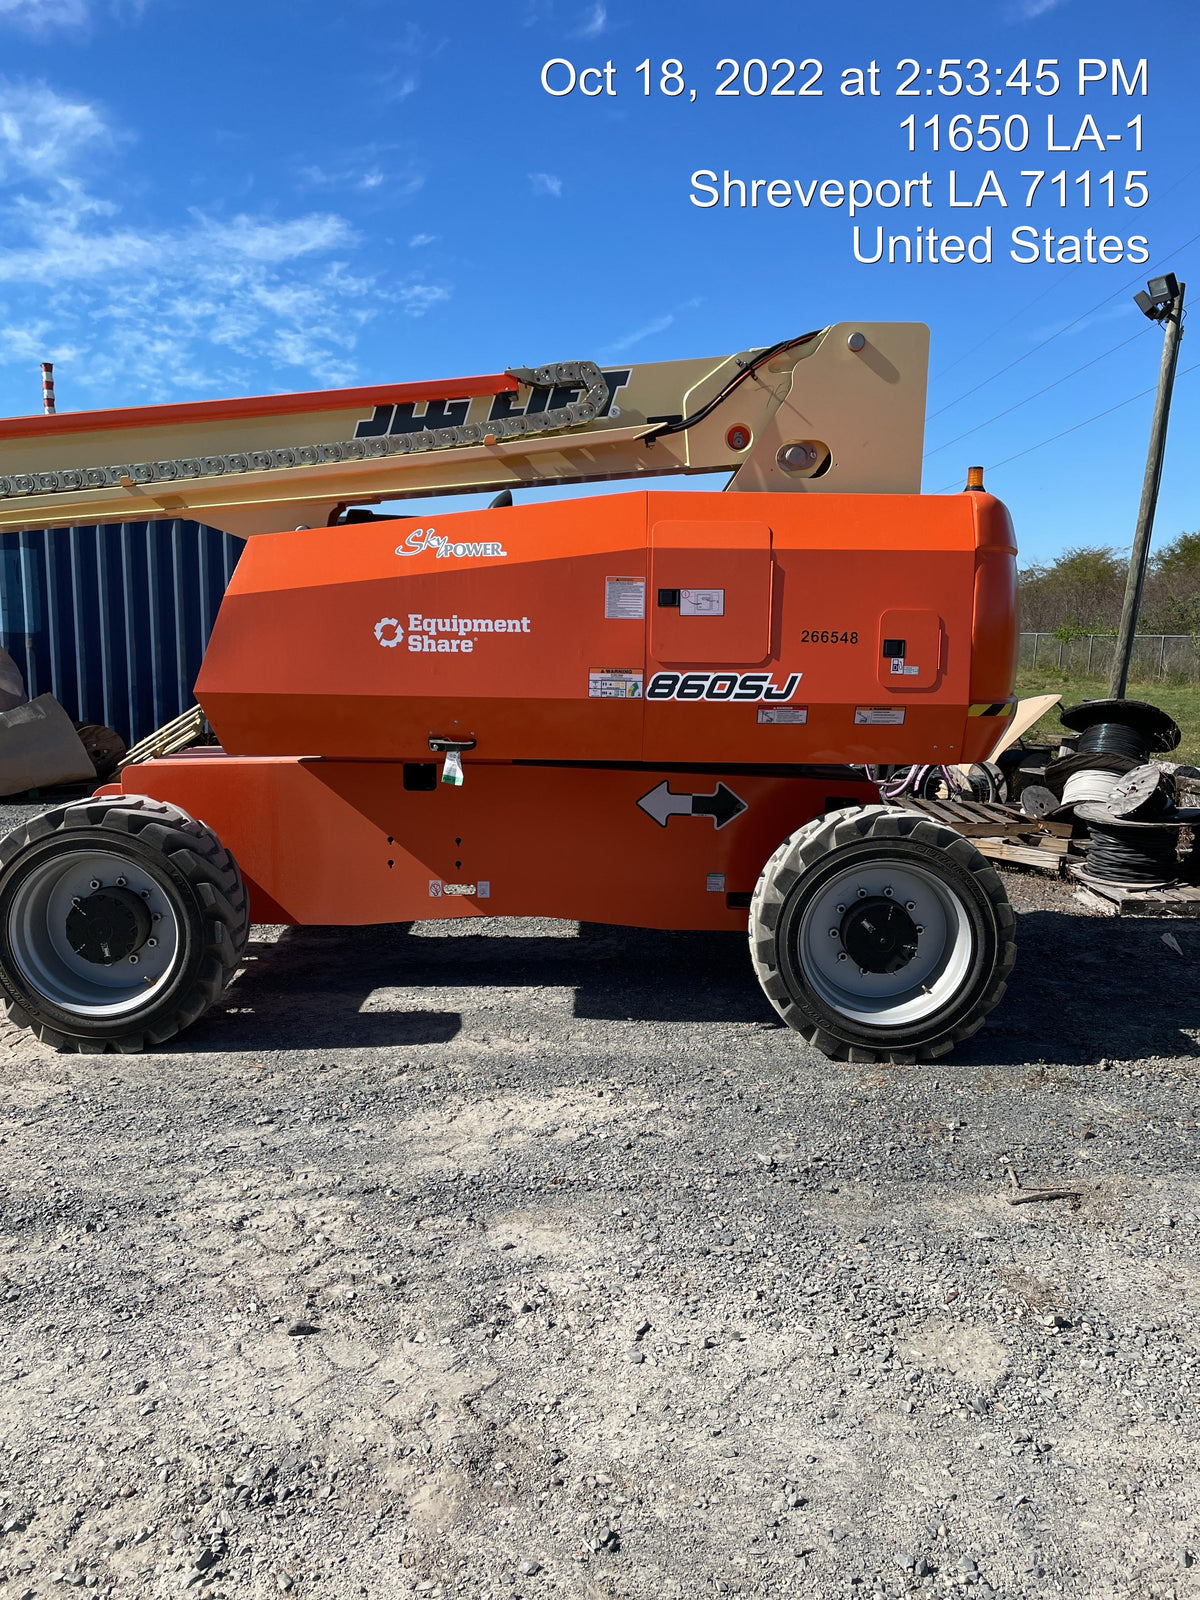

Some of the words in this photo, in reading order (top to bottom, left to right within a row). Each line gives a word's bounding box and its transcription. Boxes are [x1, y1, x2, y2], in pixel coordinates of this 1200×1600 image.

[443, 542, 502, 557] POWER
[408, 614, 531, 636] Equipment
[408, 635, 474, 653] Share
[801, 630, 859, 645] 266548
[646, 672, 802, 702] 860SJ
